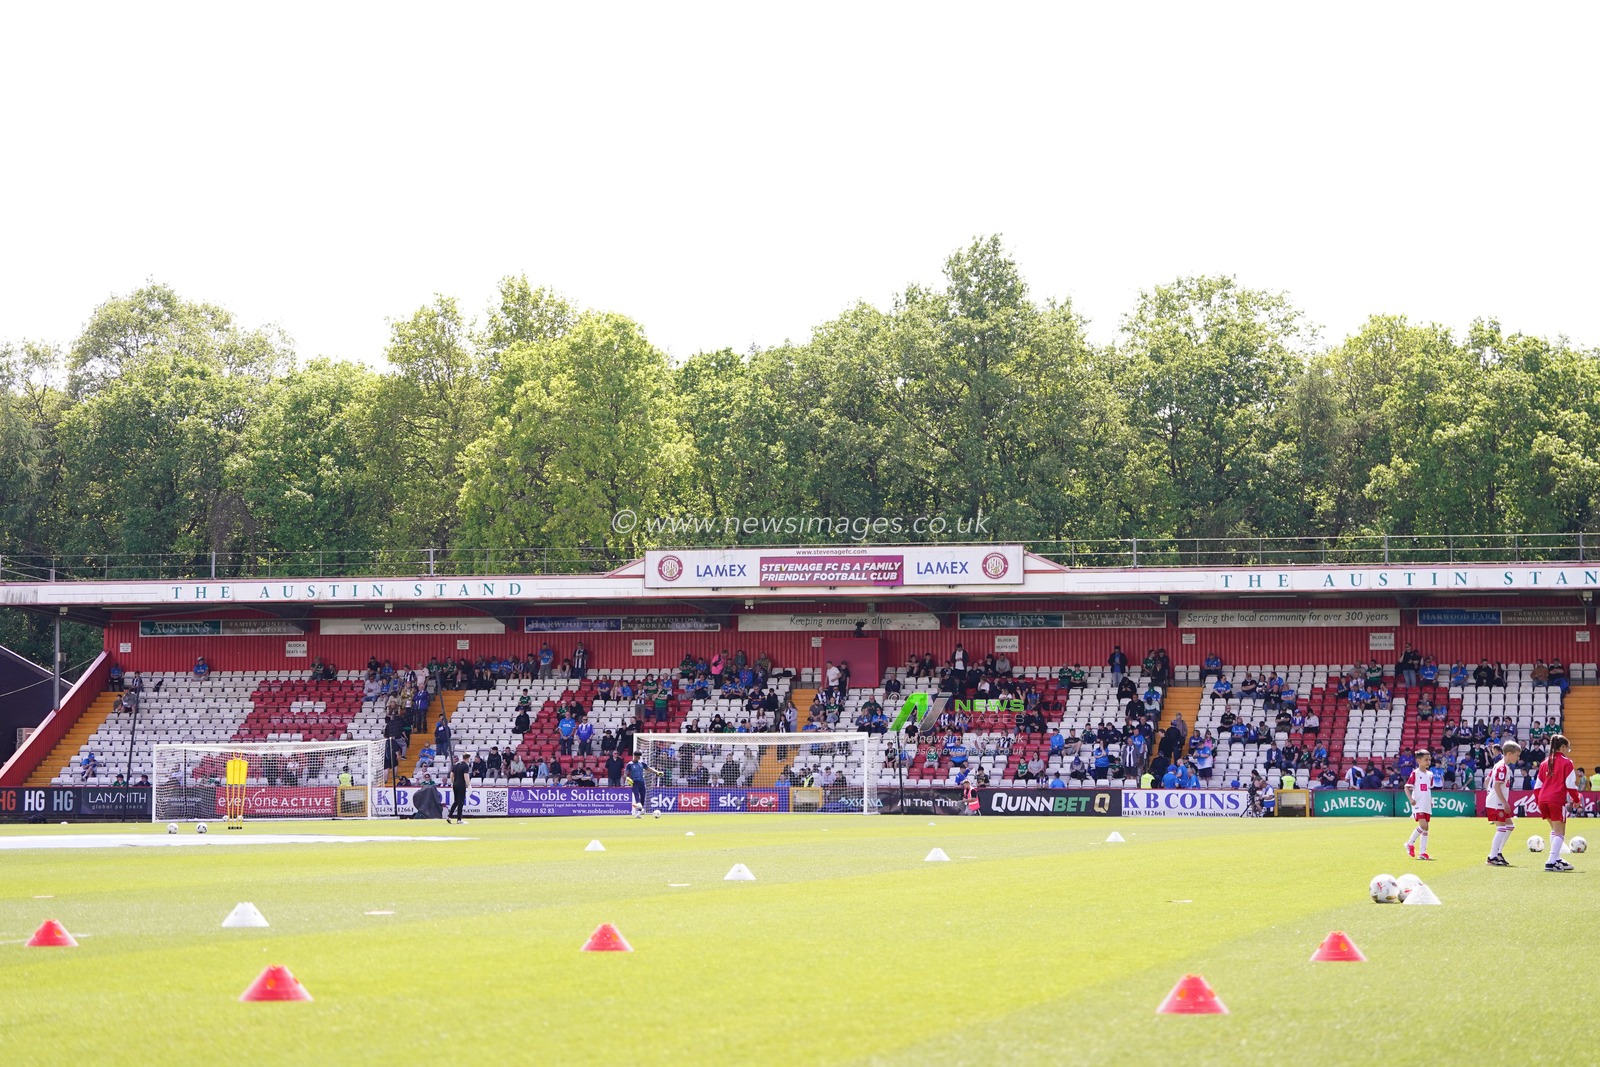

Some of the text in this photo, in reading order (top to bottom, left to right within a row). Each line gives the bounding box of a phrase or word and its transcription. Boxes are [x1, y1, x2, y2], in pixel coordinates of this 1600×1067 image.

[796, 548, 867, 556] www.stevenagefc.com
[696, 564, 747, 577] LAMEX
[761, 562, 901, 573] STEVENAGE FC IS A FAMILY
[916, 561, 969, 575] LAMEX
[762, 572, 898, 582] FRIENDLY FOOTBALL CLUB
[1220, 571, 1599, 588] THE AUSTIN STAN
[171, 582, 522, 600] THE AUSTIN STAND
[789, 616, 823, 628] Keeping
[978, 614, 1045, 627] AUSTIN'S
[1187, 612, 1217, 624] Serving
[1221, 612, 1235, 622] the
[1237, 612, 1257, 622] local
[1259, 612, 1306, 624] community
[1308, 611, 1321, 624] for
[1345, 611, 1363, 621] 300
[1365, 612, 1389, 623] years
[1422, 612, 1497, 621] HARWOOD PARK
[150, 622, 211, 634] AUSTIN'S
[363, 620, 463, 632] www.austins.co.uk
[530, 619, 617, 629] HARWOOD PARK
[24, 790, 46, 812] HG
[53, 790, 74, 812] HG
[218, 789, 278, 808] everyone
[280, 797, 332, 807] ACTIVE
[376, 790, 390, 806] K
[396, 790, 409, 805] B
[527, 789, 630, 801] Noble Solicitors
[1123, 792, 1240, 810] K B COINS
[650, 793, 707, 811] sky bet
[718, 793, 776, 811] sky bet
[897, 798, 958, 807] All The Thin
[991, 792, 1090, 812] QUINNBET
[1322, 797, 1385, 813] JAMESON
[1403, 797, 1466, 813] JESON
[1177, 810, 1240, 818] www.kbcoins.com
